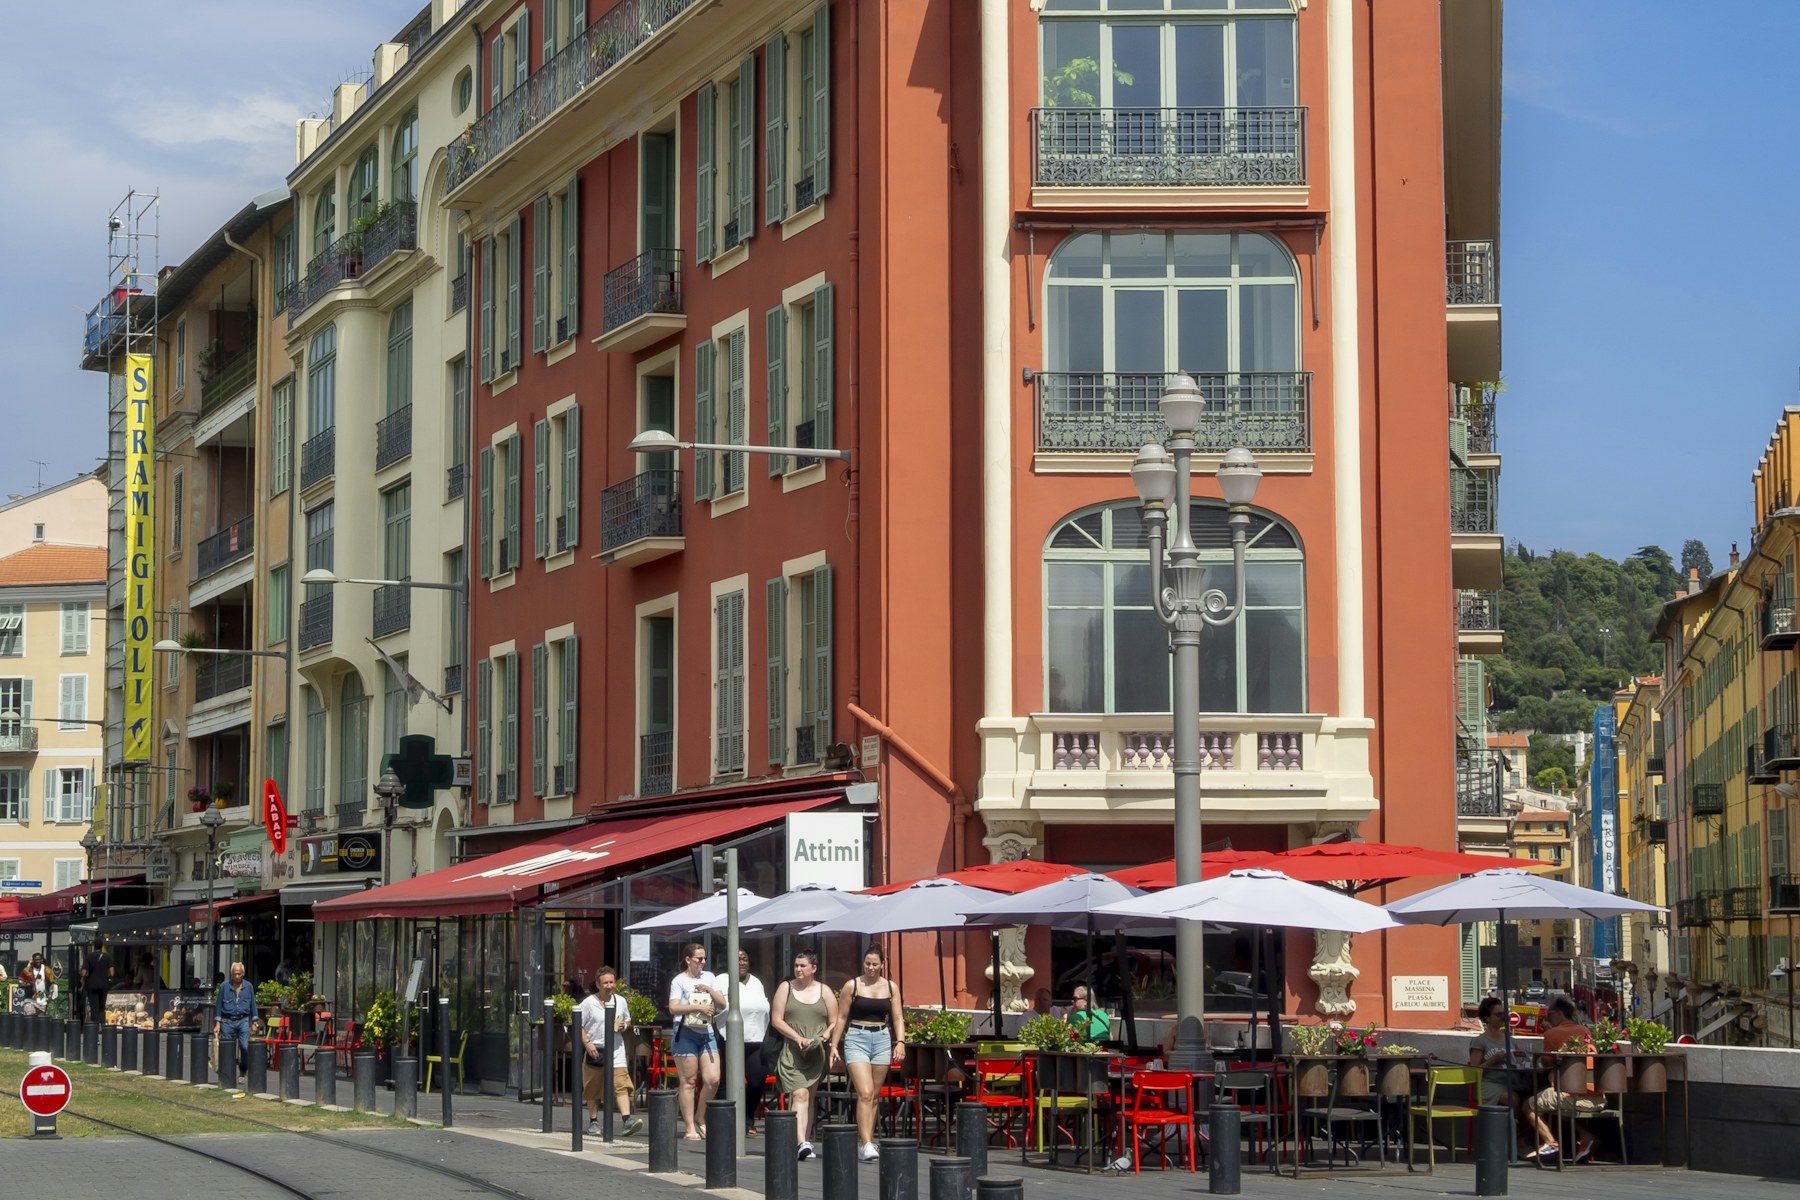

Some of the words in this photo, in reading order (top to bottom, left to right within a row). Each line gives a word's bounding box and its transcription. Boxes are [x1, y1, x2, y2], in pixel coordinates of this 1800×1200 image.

[131, 367, 150, 705] STRAMIGIOLI
[268, 794, 282, 840] TABAC
[794, 838, 859, 862] Attimi
